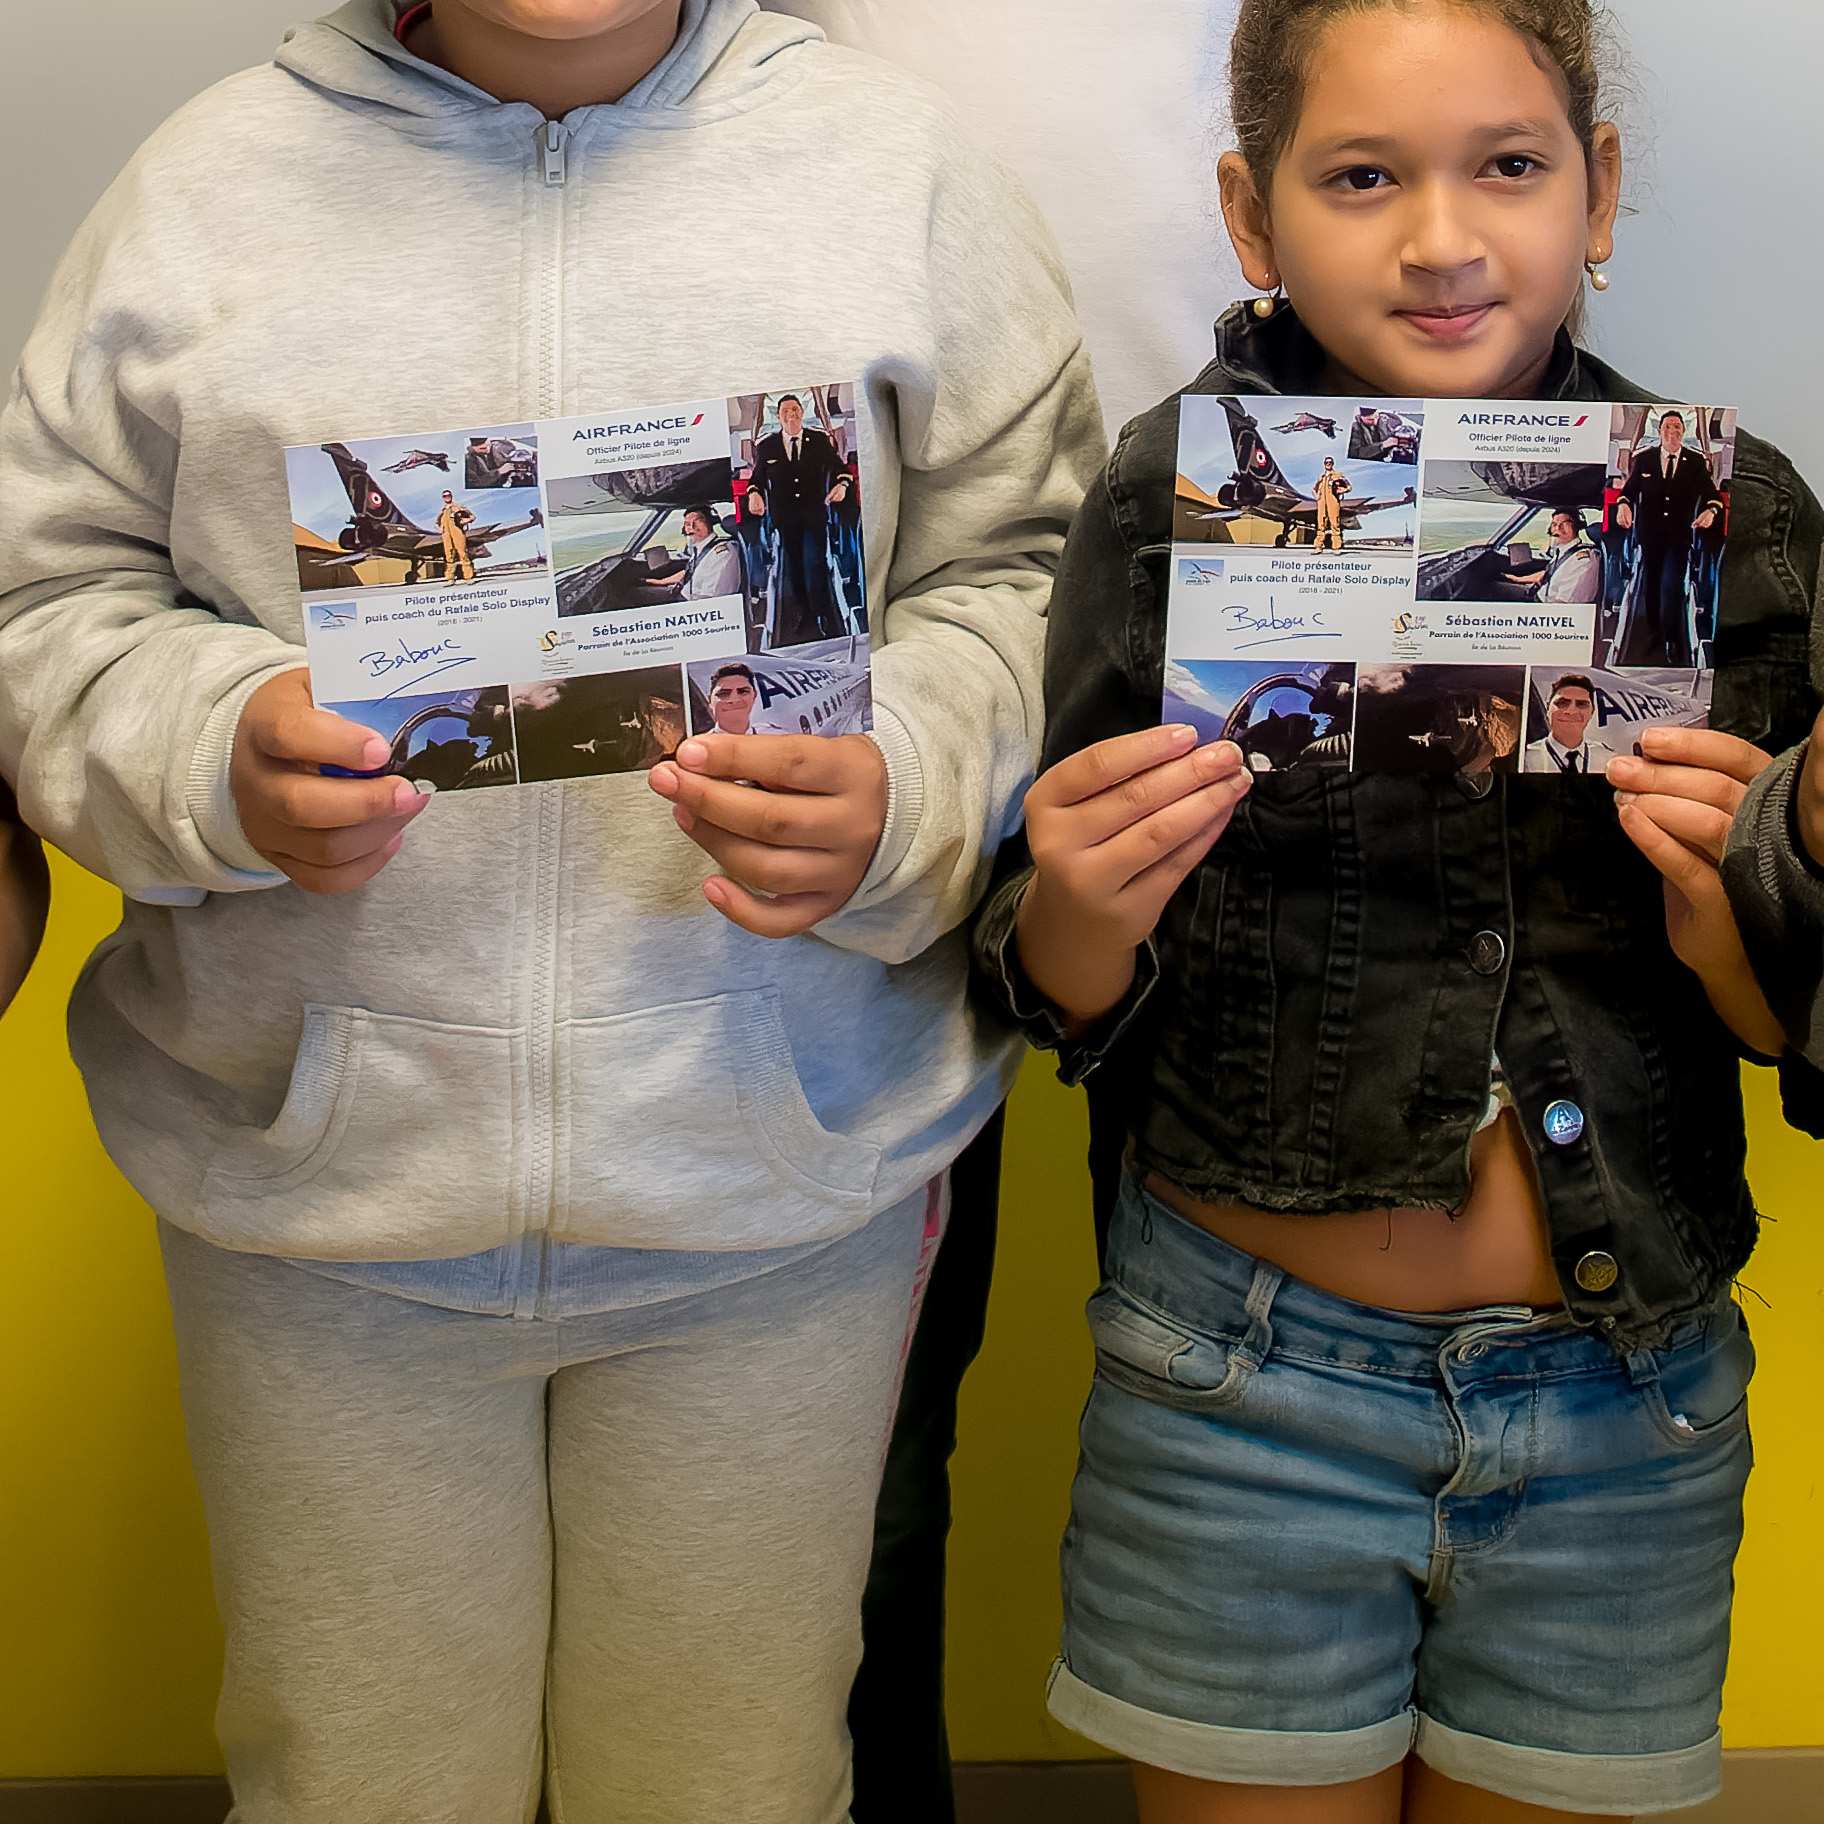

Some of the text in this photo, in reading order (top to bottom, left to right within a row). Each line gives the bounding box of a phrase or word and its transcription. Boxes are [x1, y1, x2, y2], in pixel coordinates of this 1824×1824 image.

[1457, 413, 1570, 427] AIRFRANCE
[572, 416, 686, 441] AIRFRANCE
[1469, 432, 1571, 445] Officier Pilote de ligne
[587, 436, 690, 456] Officier Pilote de ligne
[1271, 560, 1372, 573] Pilote présentateur
[1230, 574, 1253, 585] puis
[1255, 573, 1289, 584] coach
[1291, 574, 1305, 584] du
[1344, 574, 1369, 585] Solo
[1371, 575, 1411, 587] Display
[404, 588, 508, 606] Pilote présentateur
[365, 613, 389, 625] puis
[392, 609, 425, 620] coach
[428, 608, 442, 617] du
[482, 600, 507, 611] Solo
[510, 596, 550, 609] Display
[592, 610, 725, 638] Sébastien NATIVEL
[1445, 614, 1575, 628] Sébastien NATIVEL
[1428, 630, 1590, 641] Parrain de l'Association 1000 Sourires
